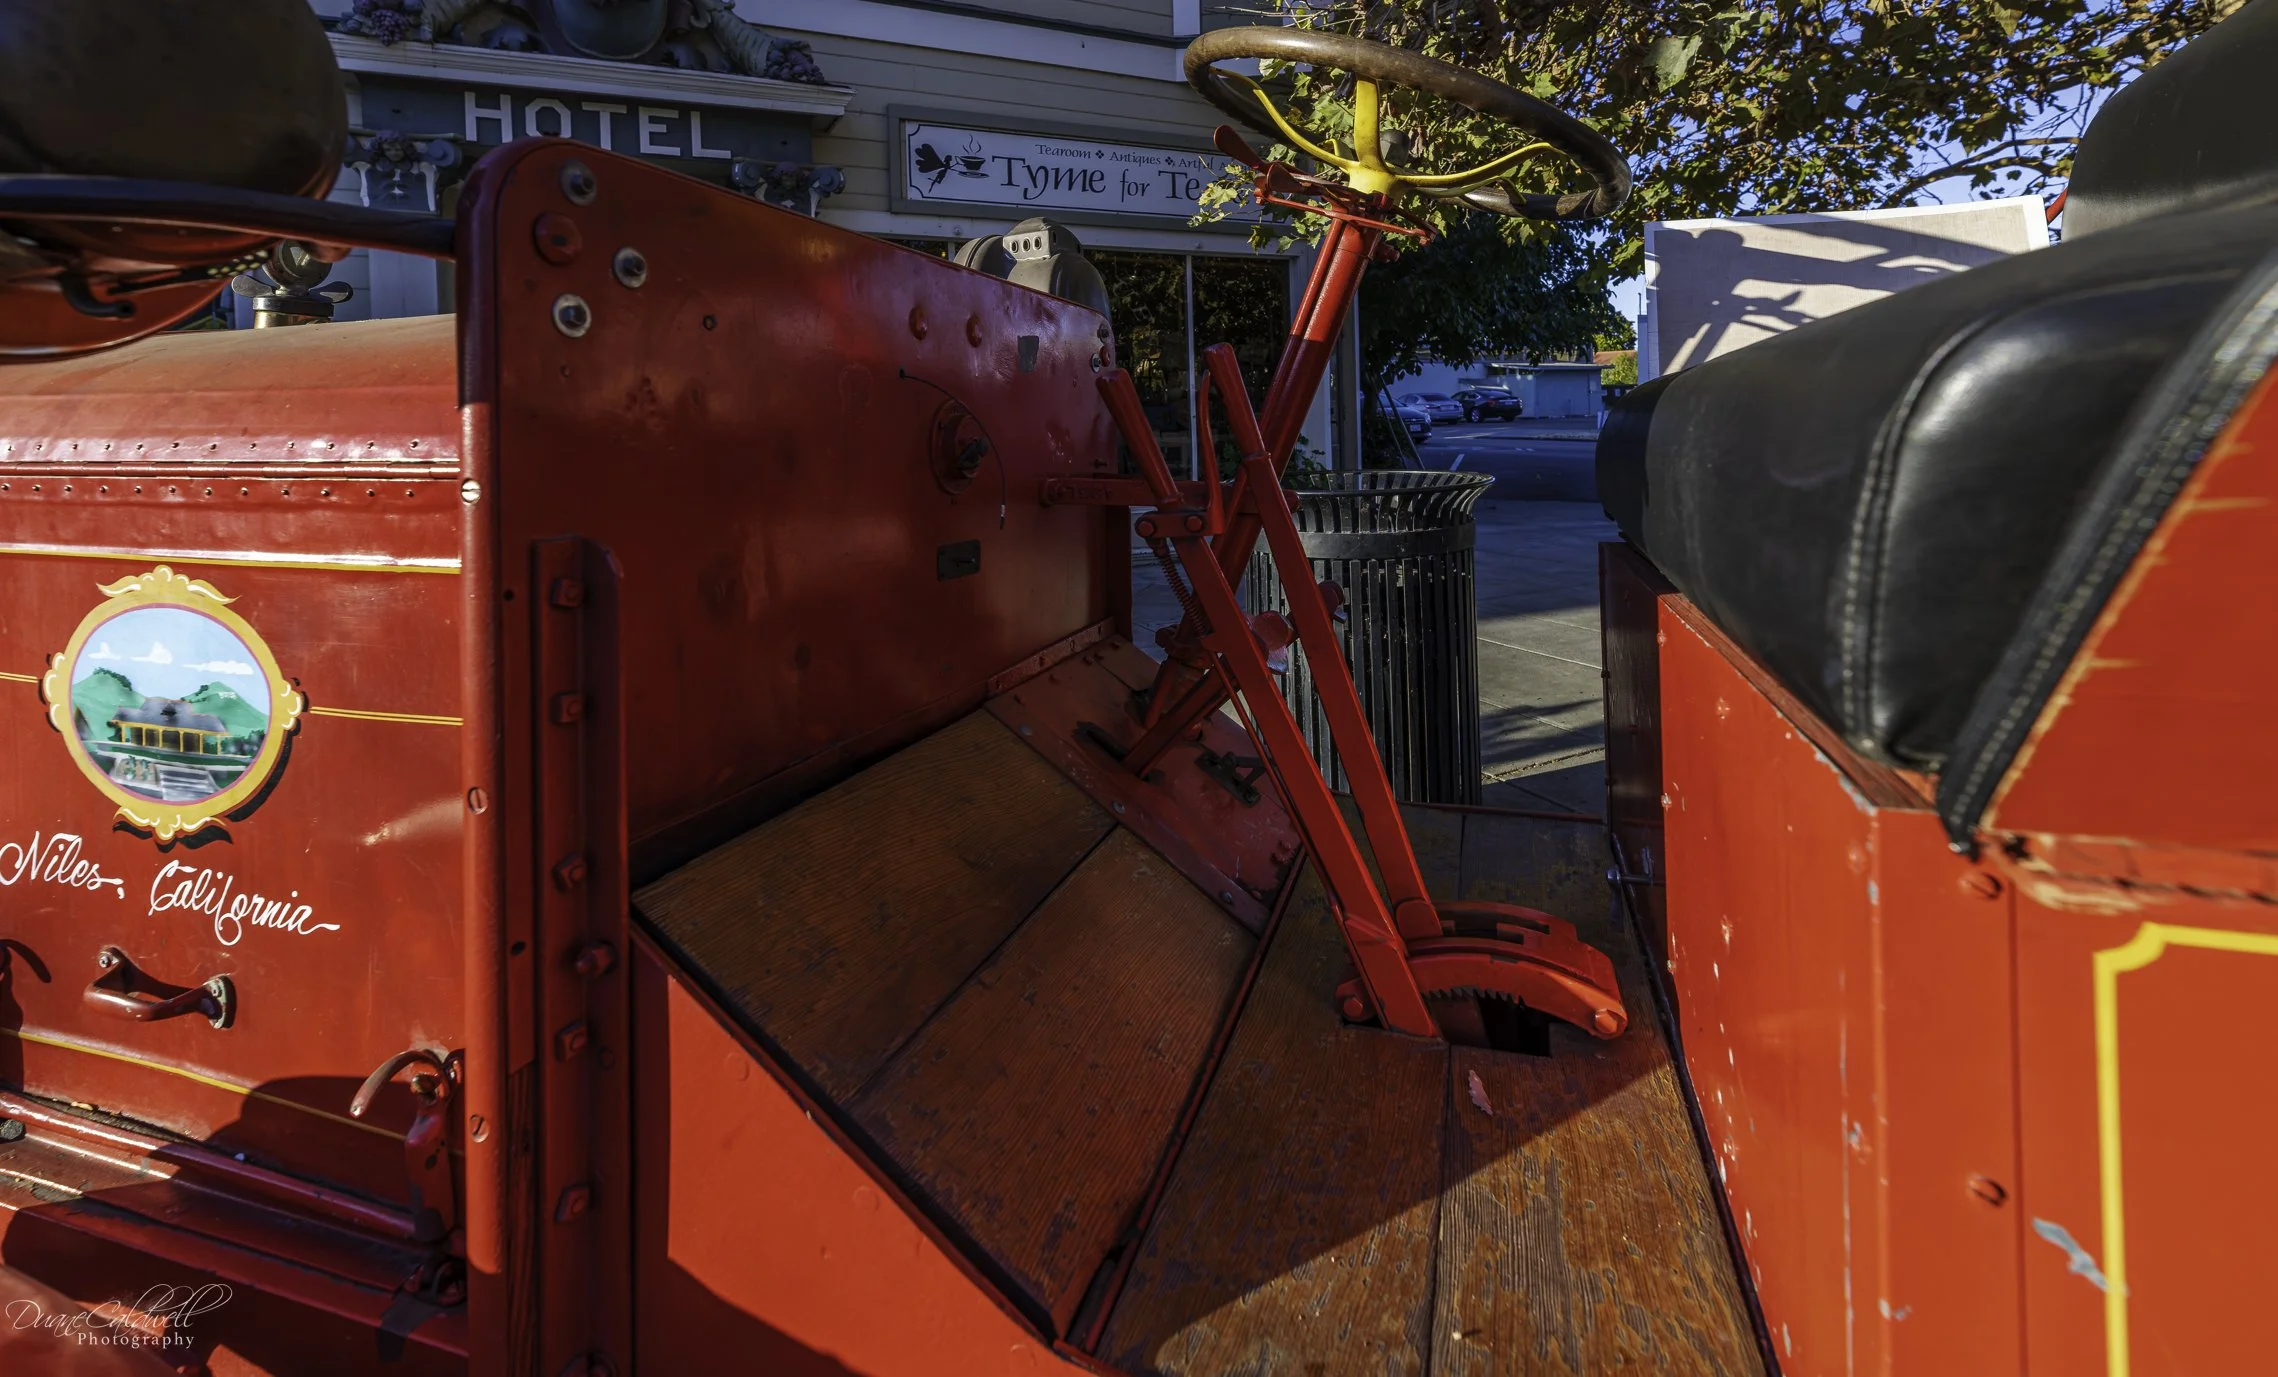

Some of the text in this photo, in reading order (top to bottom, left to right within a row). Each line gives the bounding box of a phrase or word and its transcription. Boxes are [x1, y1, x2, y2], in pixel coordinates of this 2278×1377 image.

[465, 92, 732, 159] HOTEL
[992, 155, 1106, 200] Tyme
[1120, 169, 1151, 202] for
[1158, 170, 1219, 202] Te
[1035, 144, 1092, 159] Tearoom
[1108, 151, 1162, 166] Antiques
[0, 831, 340, 946] Niles, California
